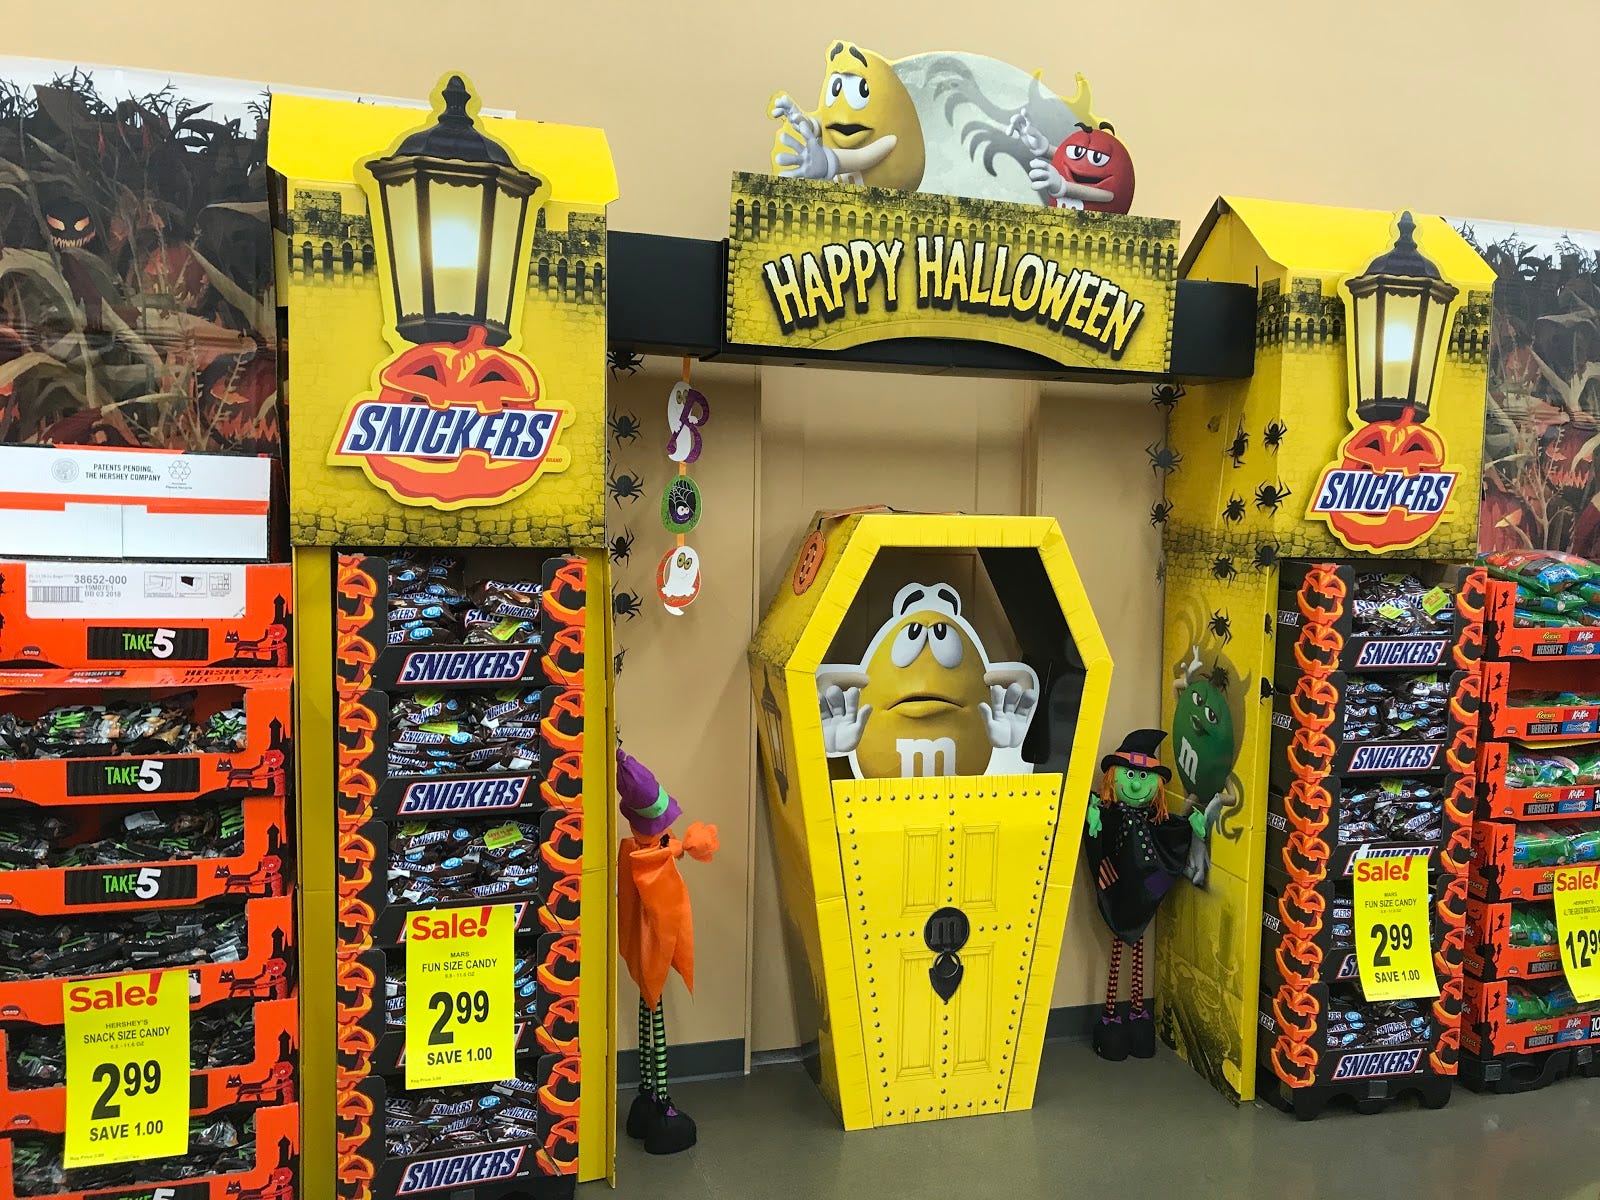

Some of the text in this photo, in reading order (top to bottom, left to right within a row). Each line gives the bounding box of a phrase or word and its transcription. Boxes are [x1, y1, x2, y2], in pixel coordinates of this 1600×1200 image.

[764, 236, 1144, 352] HAPPY HALLOWEEN
[347, 404, 553, 458] SNICKERS
[93, 463, 121, 471] PATENTS
[99, 473, 128, 481] HERSHEY
[130, 474, 161, 482] COMPANY
[1321, 472, 1452, 512] SNICKERS
[74, 575, 127, 585] 38652-000
[1360, 641, 1444, 665] SNICKERS
[402, 651, 527, 682] SNICKERS
[1352, 745, 1437, 770] SNICKERS
[403, 778, 526, 812] SNICKERS
[1357, 856, 1413, 882] Sale!
[1556, 866, 1600, 892] Sale!
[1365, 898, 1417, 908] FUN SIZE CANDY
[411, 906, 493, 941] Sale!
[422, 958, 498, 973] FUN SIZE CANDY
[1374, 969, 1420, 983] SAVE 1.00
[69, 972, 163, 1013] Sale!
[83, 1026, 170, 1044] SNACK SIZE CANDY
[105, 1019, 149, 1029] HERSHEY'S
[426, 1047, 492, 1066] SAVE 1.00
[1335, 1049, 1420, 1078] SNICKERS
[90, 1119, 164, 1142] SAVE 1.00
[401, 1148, 521, 1192] SNICKERS
